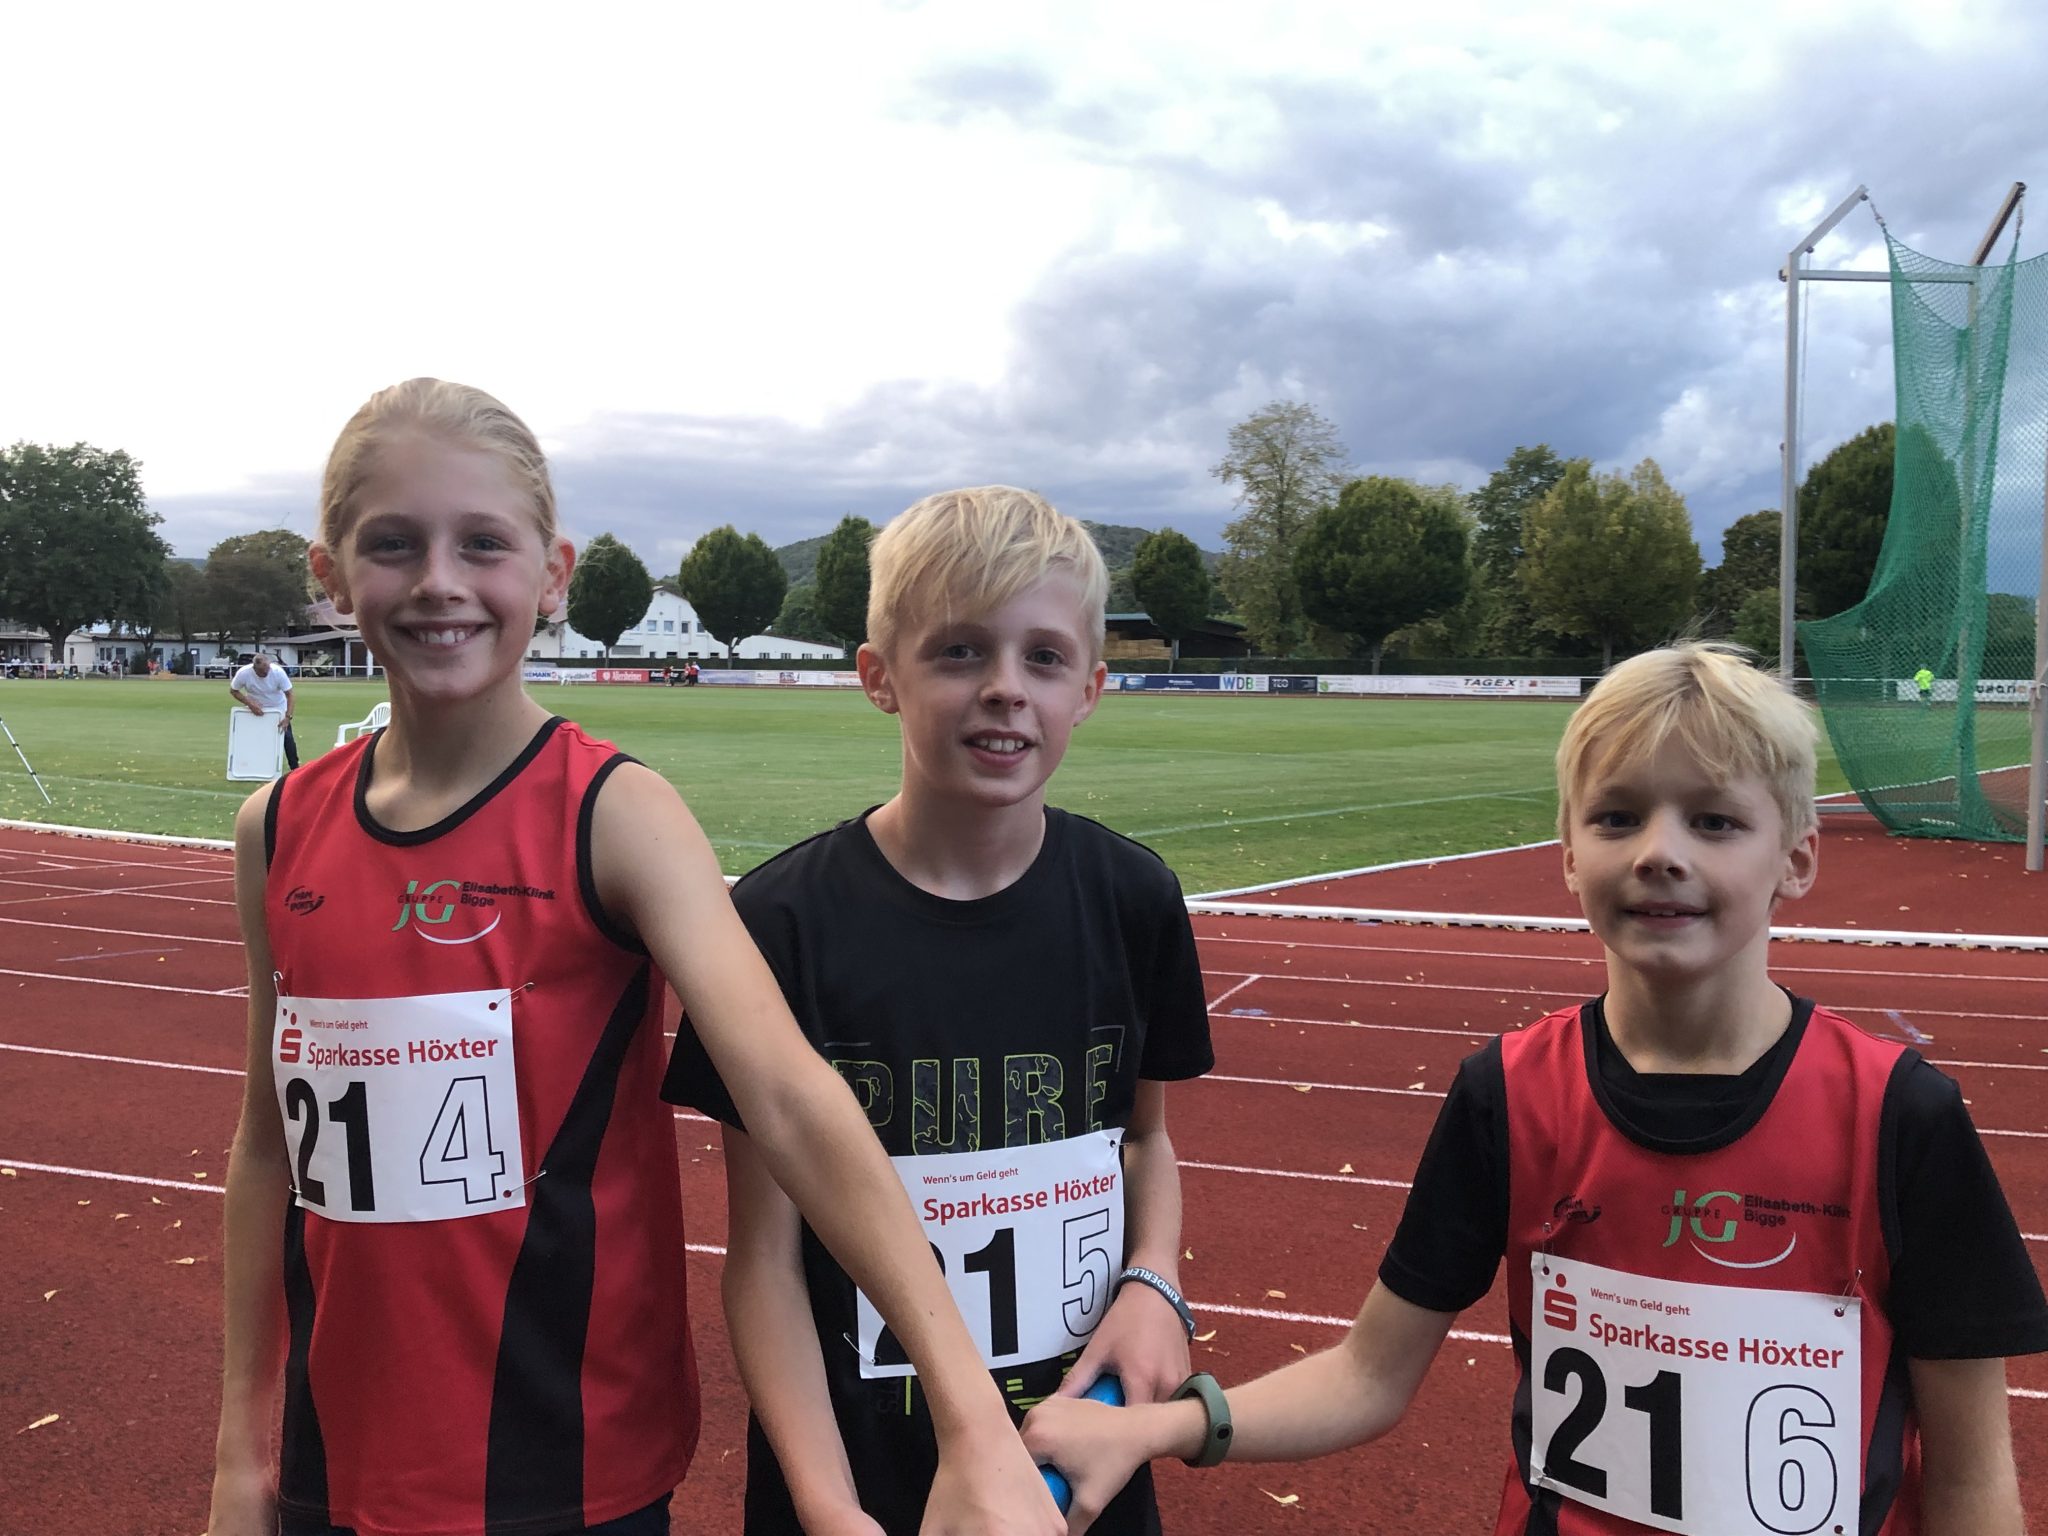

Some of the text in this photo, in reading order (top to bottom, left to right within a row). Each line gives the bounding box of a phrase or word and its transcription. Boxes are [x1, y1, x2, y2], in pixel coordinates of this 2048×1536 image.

[1223, 676, 1254, 690] WDB
[1464, 678, 1517, 687] TAGEX
[460, 892, 496, 907] Bigge
[462, 880, 557, 901] Elisabeth-Klinik
[335, 1020, 349, 1029] Geld
[350, 1019, 369, 1032] geht
[306, 1037, 499, 1070] Sparkasse Höxter
[922, 1167, 1019, 1185] Wenn's um Geld geht
[923, 1173, 1117, 1226] Sparkasse Höxter
[1744, 1208, 1787, 1228] Bigge
[1590, 1287, 1691, 1317] Wenn's um Geld geht
[1588, 1313, 1844, 1369] Sparkasse Höxter
